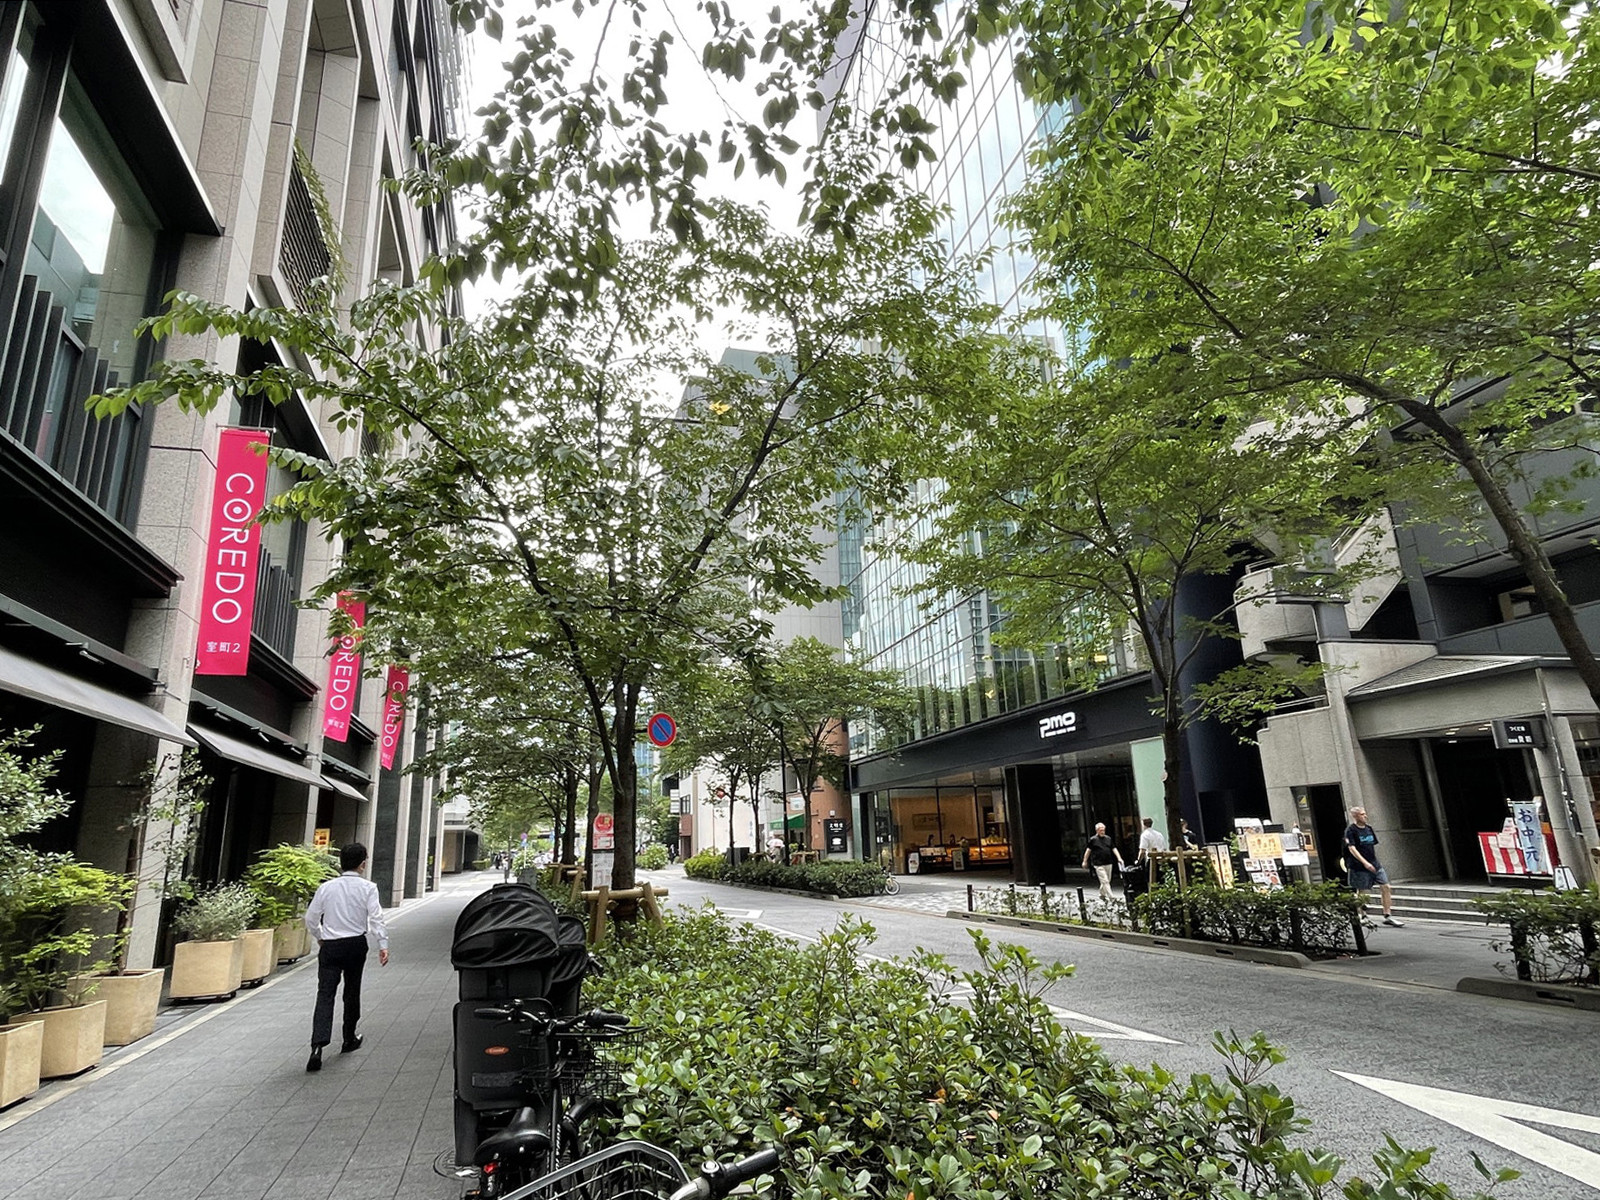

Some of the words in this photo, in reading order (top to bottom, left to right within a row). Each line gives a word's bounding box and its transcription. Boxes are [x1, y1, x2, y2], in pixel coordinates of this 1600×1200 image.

[212, 473, 254, 624] COREDO
[206, 641, 241, 653] 室町2
[1039, 711, 1076, 738] pmo
[1518, 808, 1540, 862] お中元
